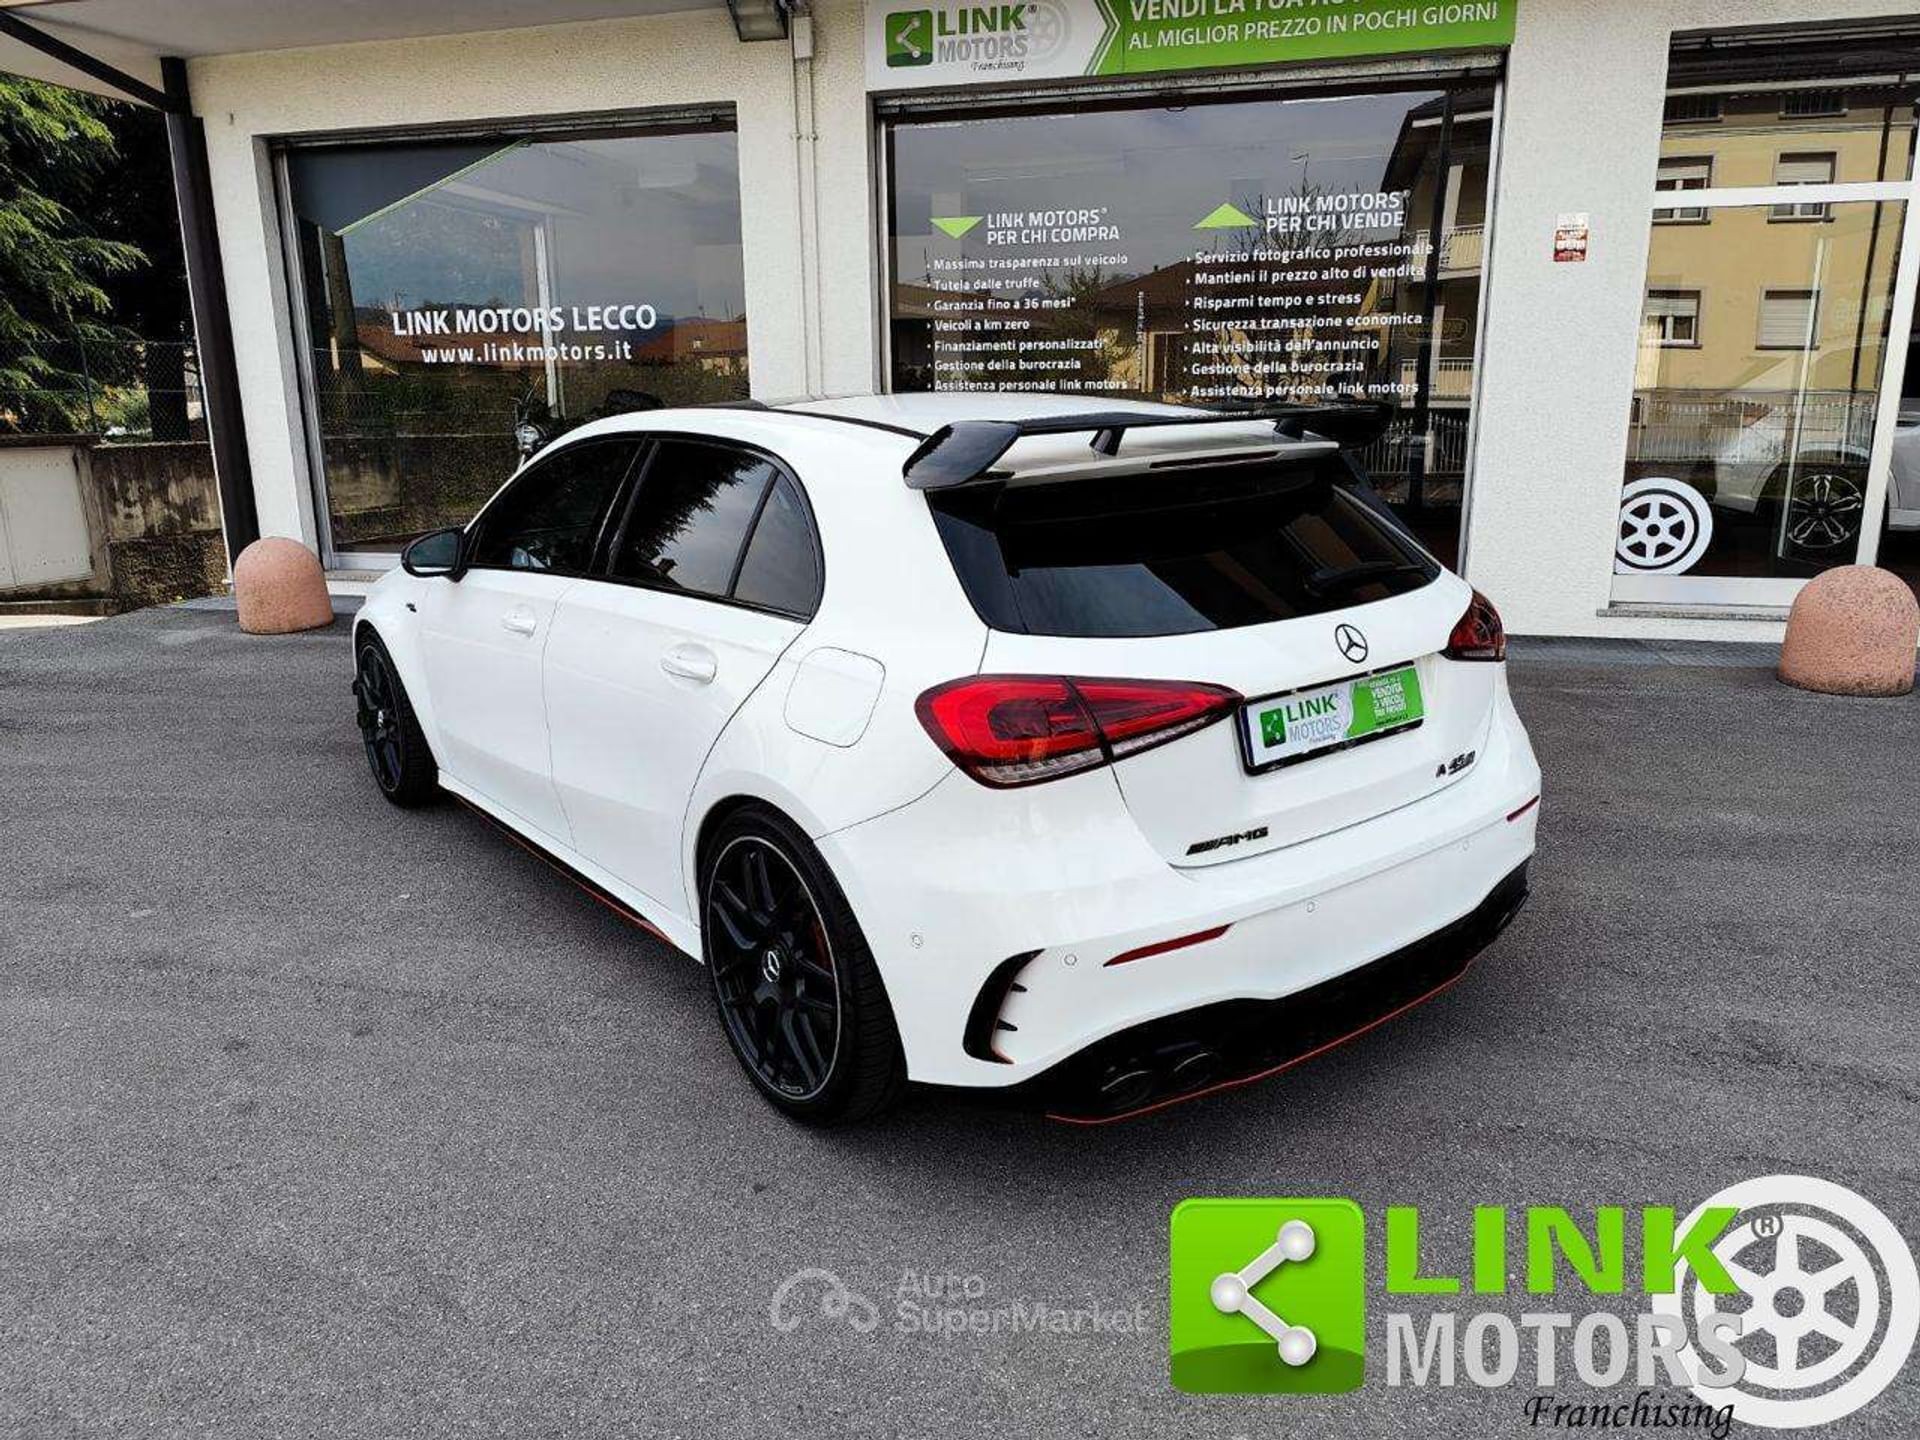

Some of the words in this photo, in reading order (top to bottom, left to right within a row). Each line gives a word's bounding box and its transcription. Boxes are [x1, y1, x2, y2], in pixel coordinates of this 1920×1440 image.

[937, 5, 1026, 36] LINK
[1131, 0, 1206, 21] VENDI
[1129, 32, 1152, 49] AL
[1157, 24, 1239, 47] MIGLIOR
[1245, 17, 1321, 40] PREZZO
[1326, 15, 1347, 33] IN
[1353, 9, 1416, 31] POCHI
[1423, 2, 1498, 25] GIORNI
[937, 35, 1027, 63] MOTORS
[1267, 198, 1310, 214] LINK
[1316, 192, 1401, 211] MOTORS
[987, 213, 1023, 228] LINK
[1028, 210, 1100, 227] MOTORS
[1266, 216, 1301, 233] PER
[1306, 214, 1336, 230] CHI
[1342, 211, 1405, 229] VENDE
[987, 230, 1017, 245] PER
[1021, 228, 1047, 244] CHI
[1052, 226, 1120, 242] COMPRA
[933, 259, 985, 271] Massima
[989, 257, 1060, 271] trasparenza
[1063, 255, 1081, 266] sul
[1085, 253, 1128, 266] veicolo
[1195, 251, 1250, 265] Servizio
[1253, 246, 1330, 264] fotografico
[1334, 243, 1433, 261] professionale
[934, 279, 970, 291] Tutela
[973, 278, 1001, 290] dalle
[1005, 277, 1039, 289] truffe
[1195, 271, 1256, 285] Mantieni
[1259, 270, 1268, 282] il
[1271, 270, 1317, 285] prezzo
[1321, 268, 1349, 281] alto
[1353, 266, 1366, 279] di
[1370, 263, 1425, 278] vendita
[934, 300, 984, 311] Garanzia
[987, 299, 1010, 310] fino
[1023, 298, 1039, 309] 36
[1193, 295, 1255, 311] Risparmi
[1258, 294, 1302, 309] tempo
[1305, 295, 1314, 305] e
[1317, 291, 1362, 305] stress
[392, 310, 450, 336] LINK
[455, 306, 565, 334] MOTORS
[572, 304, 657, 332] LECCO
[935, 320, 972, 331] Veicoli
[974, 322, 981, 330] a
[984, 319, 1002, 330] km
[1004, 320, 1030, 330] zero
[1192, 319, 1257, 332] Sicurezza
[1260, 315, 1342, 329] transazione
[1346, 312, 1423, 327] economica
[421, 340, 632, 363] www.linkmotors.it
[935, 340, 1016, 352] Finanziamenti
[1019, 339, 1104, 353] personalizzati
[1192, 341, 1219, 354] Alta
[1222, 339, 1281, 353] visibilità
[935, 359, 985, 371] Gestione
[987, 359, 1016, 370] della
[1019, 358, 1081, 370] burocrazia
[1191, 362, 1250, 375] Gestione
[1253, 362, 1287, 374] della
[1291, 360, 1364, 373] burocrazia
[935, 380, 996, 392] Assistenza
[999, 379, 1057, 393] personale
[1060, 379, 1081, 390] link
[1084, 379, 1128, 390] motors
[1190, 384, 1262, 398] Assistenza
[1266, 383, 1334, 399] personale
[1338, 381, 1363, 394] link
[1368, 380, 1419, 394] motors
[1286, 693, 1337, 722] LINK
[1288, 716, 1341, 742] MOTORS
[1436, 764, 1446, 778] A
